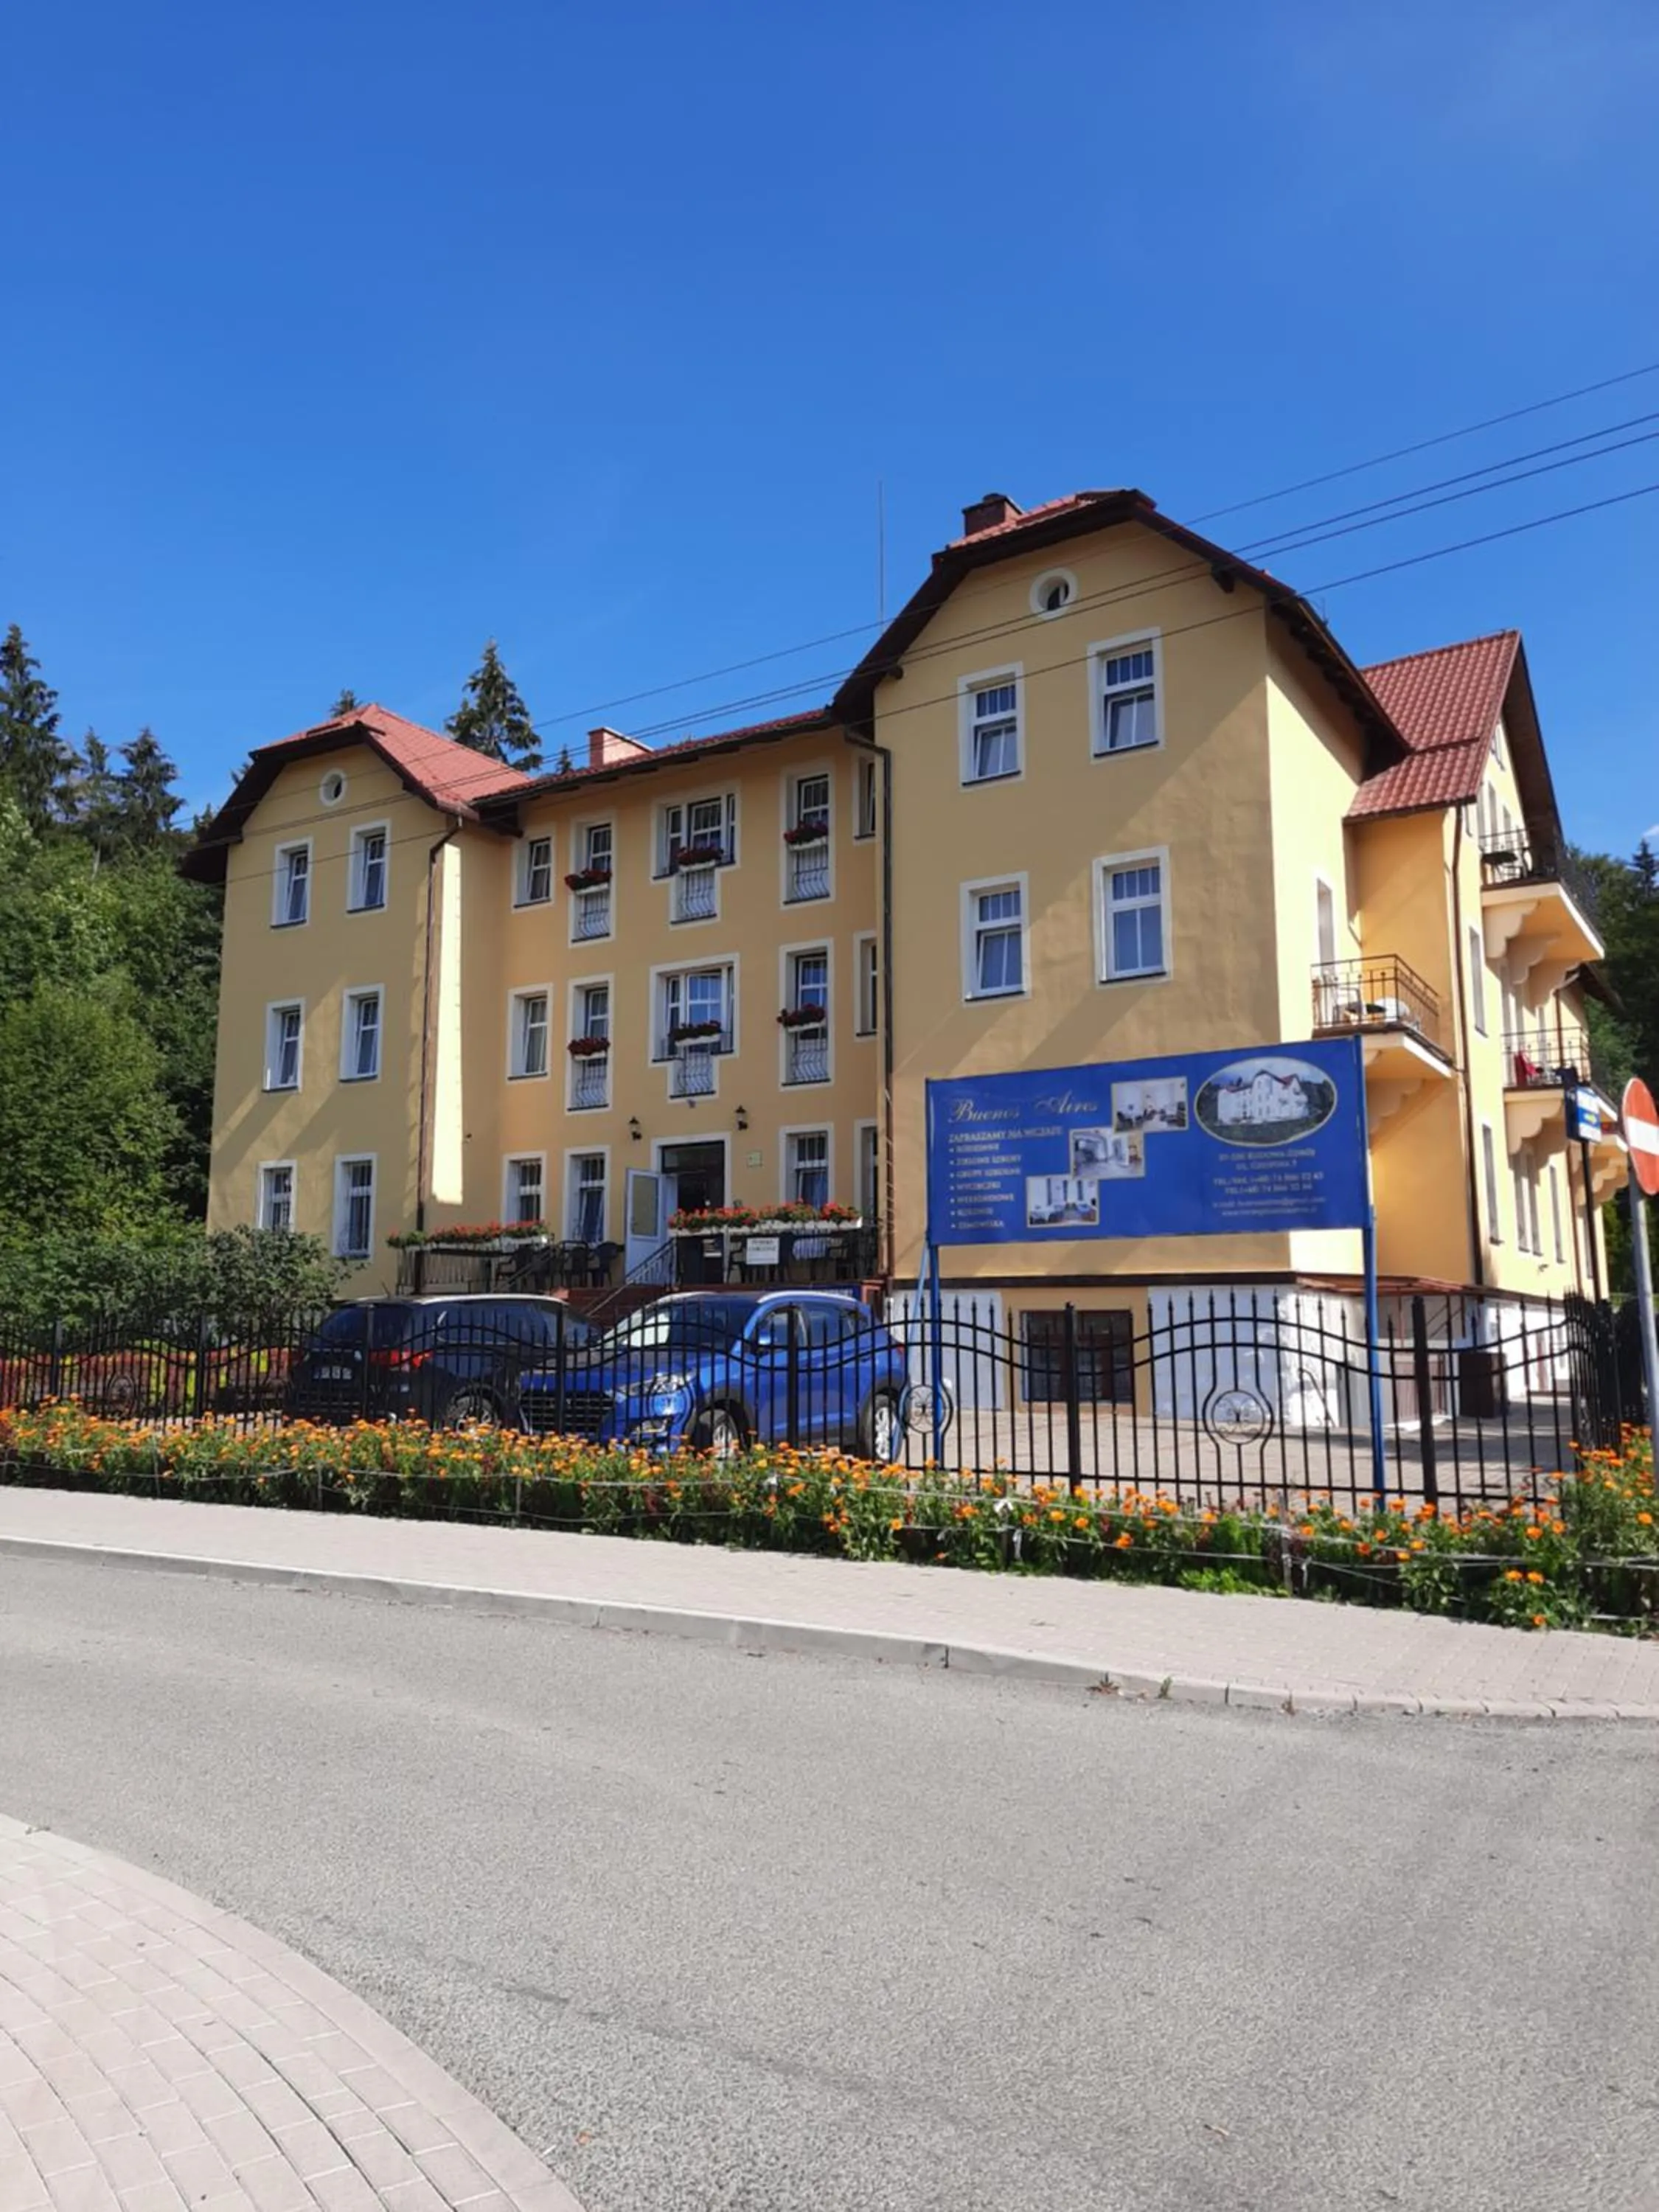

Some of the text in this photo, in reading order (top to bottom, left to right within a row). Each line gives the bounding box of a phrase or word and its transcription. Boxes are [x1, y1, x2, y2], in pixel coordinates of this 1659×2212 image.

[947, 1088, 1098, 1123] Buenos Aires
[948, 1130, 1006, 1144] ZAPRASZAMY
